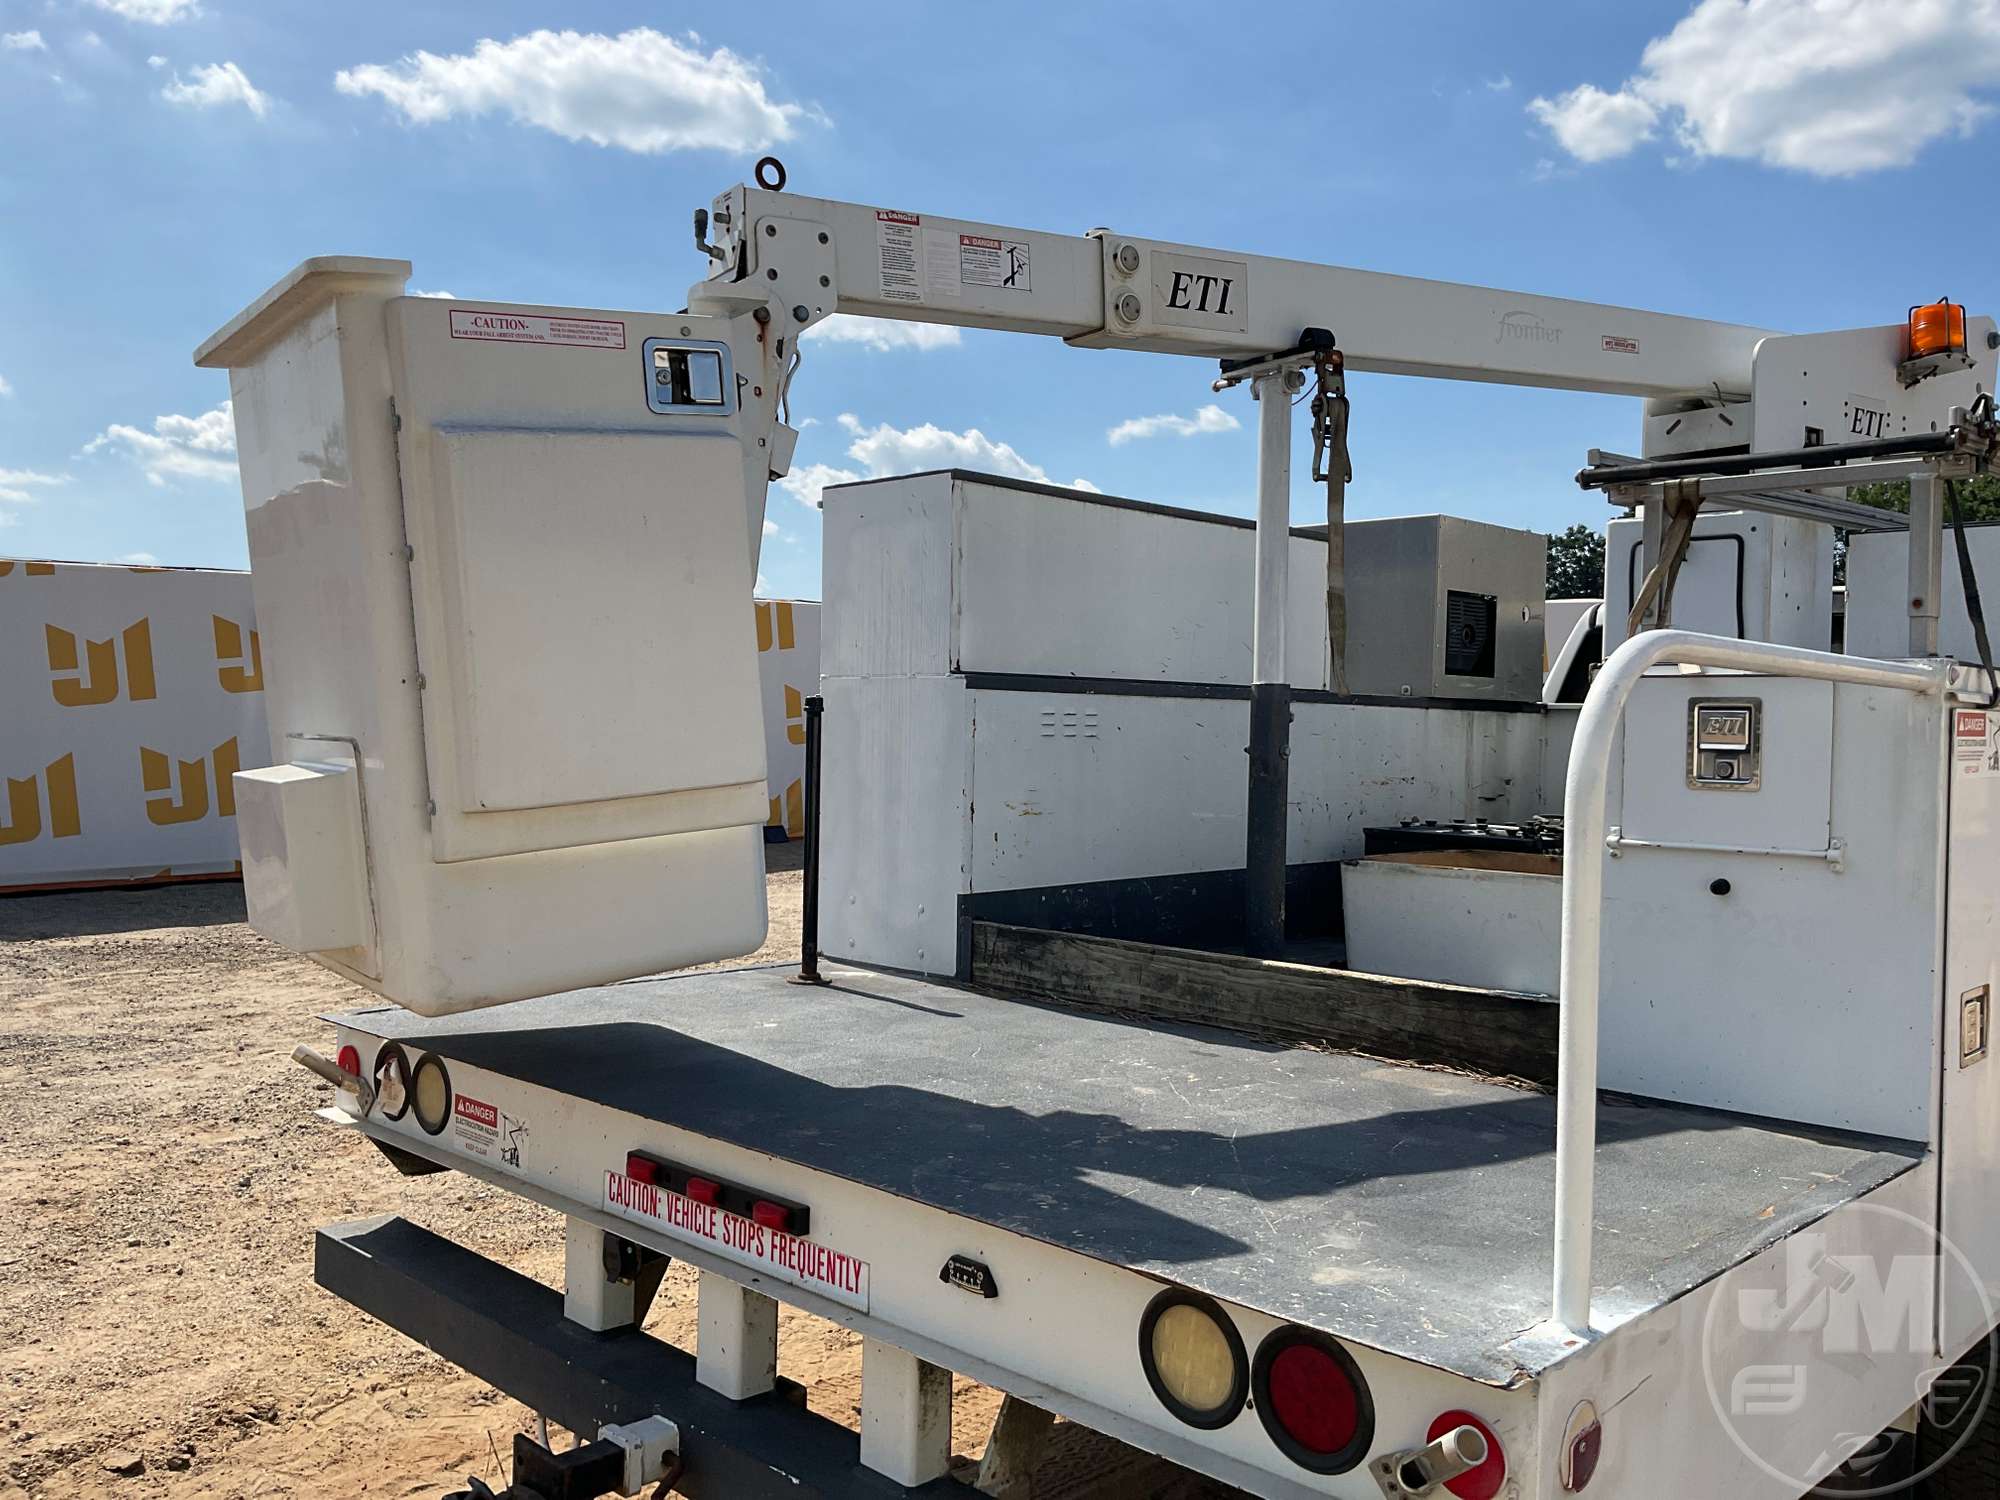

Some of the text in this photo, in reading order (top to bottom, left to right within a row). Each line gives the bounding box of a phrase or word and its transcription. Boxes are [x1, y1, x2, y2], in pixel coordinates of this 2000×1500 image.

[465, 1102, 495, 1122] DANGER
[608, 1172, 862, 1294] CAUTION: VEHICLE STOPS FREQUENTLY
